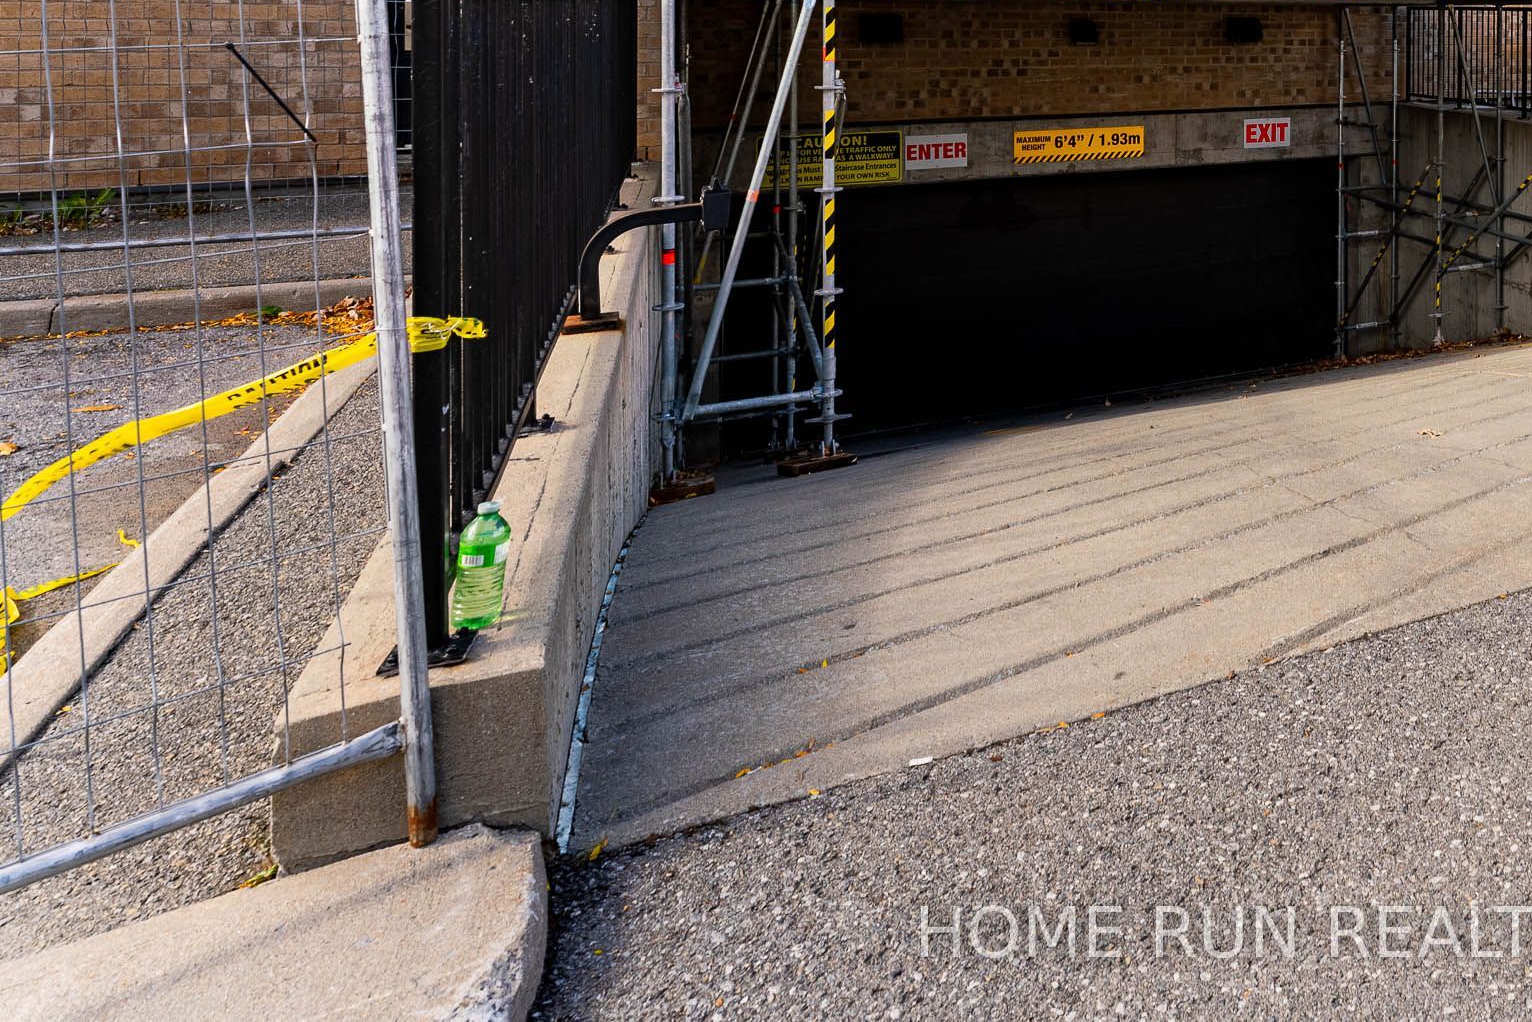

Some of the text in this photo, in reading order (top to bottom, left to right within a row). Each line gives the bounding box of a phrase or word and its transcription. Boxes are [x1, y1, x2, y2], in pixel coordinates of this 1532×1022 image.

[1098, 131, 1141, 147] 1.93m
[1245, 122, 1289, 144] EXIT
[1016, 135, 1051, 145] MAXIMUM
[906, 142, 967, 162] ENTER
[1021, 143, 1046, 152] HEIGHT
[865, 162, 897, 170] Entrances
